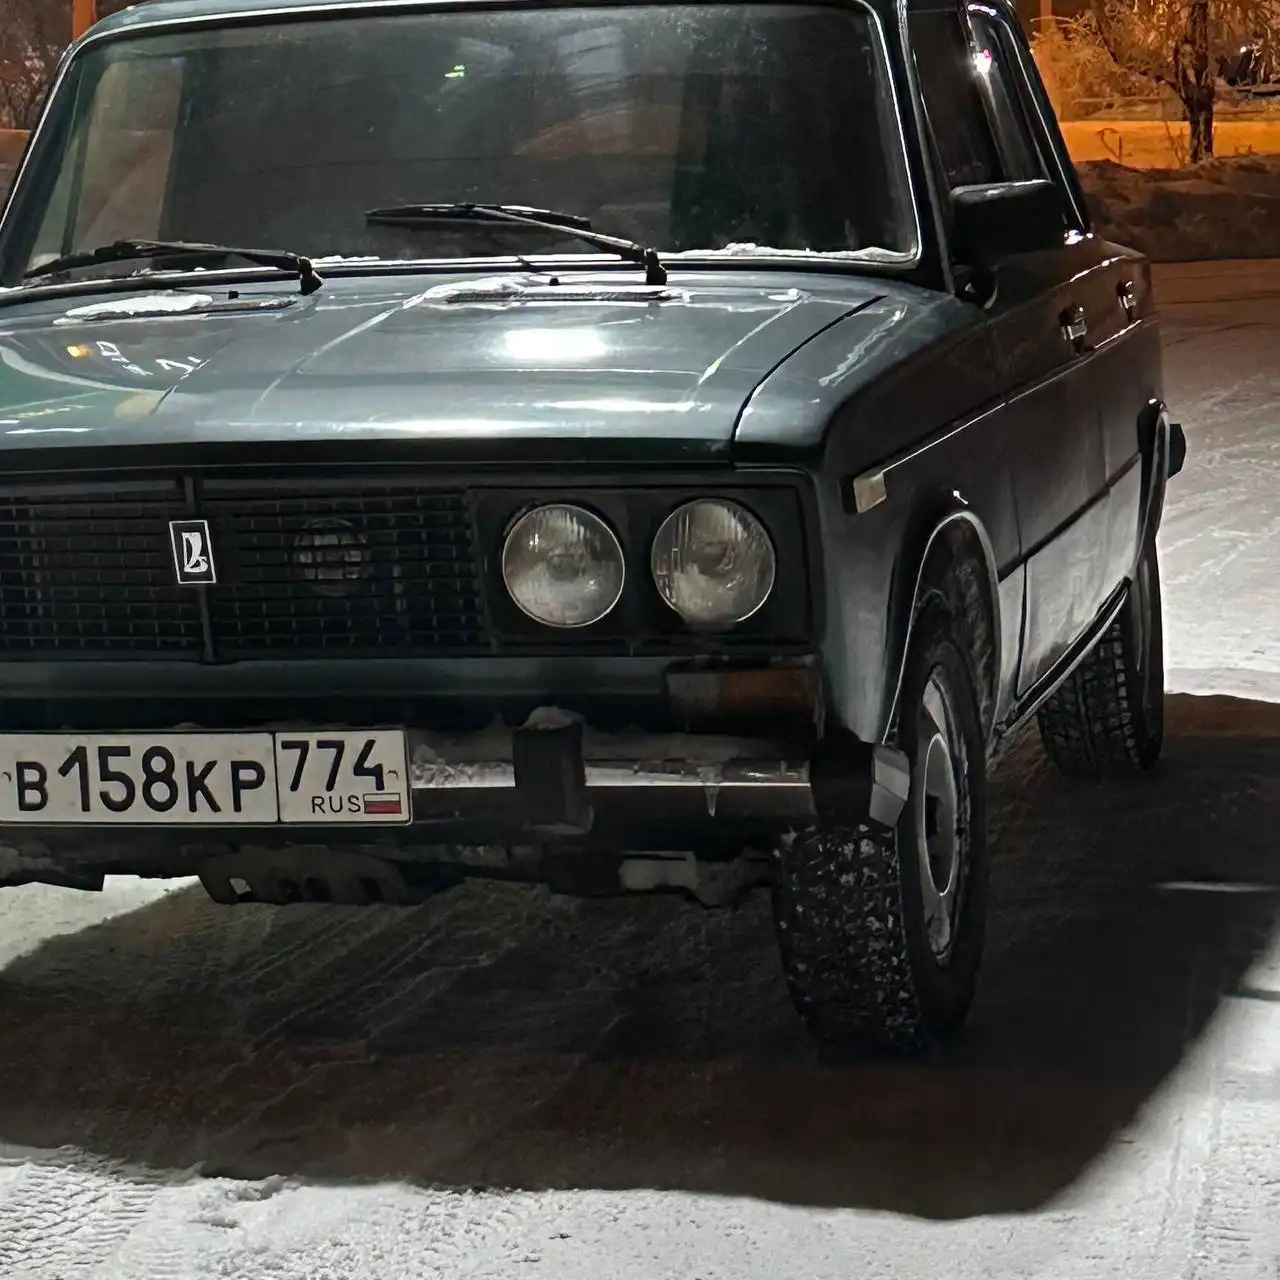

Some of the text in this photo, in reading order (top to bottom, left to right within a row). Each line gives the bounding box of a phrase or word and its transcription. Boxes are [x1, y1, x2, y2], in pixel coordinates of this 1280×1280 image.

[15, 739, 385, 813] В158КР 774
[311, 794, 361, 815] RUS
